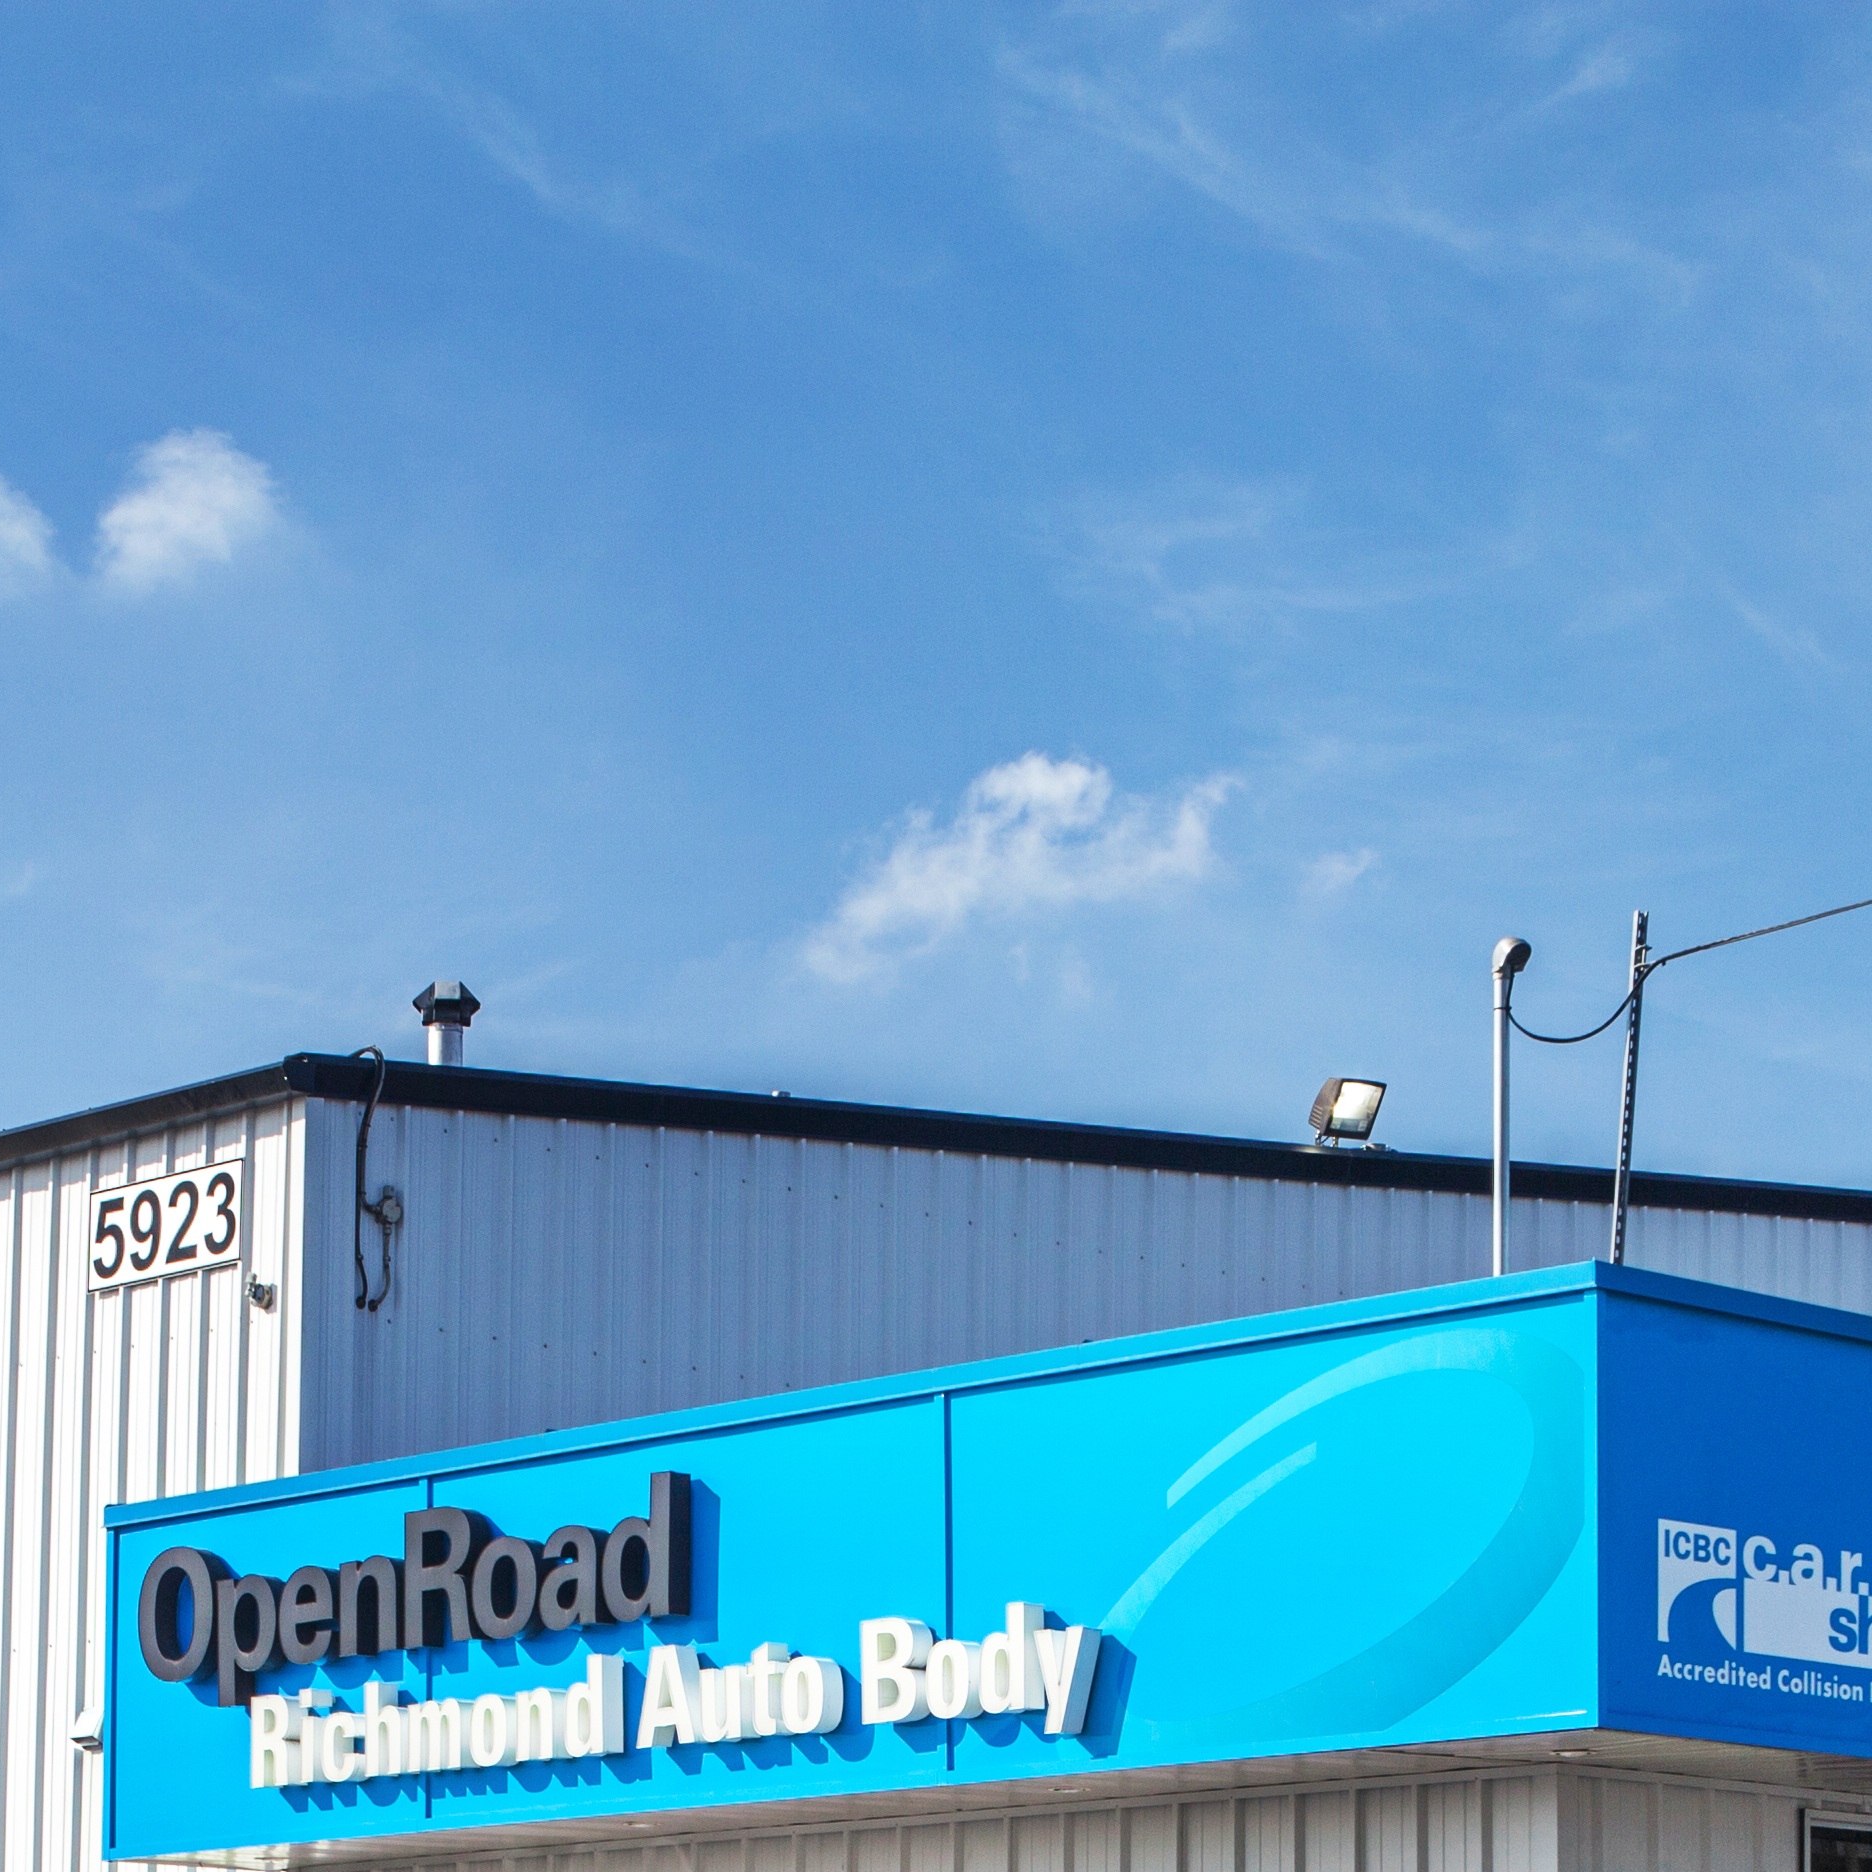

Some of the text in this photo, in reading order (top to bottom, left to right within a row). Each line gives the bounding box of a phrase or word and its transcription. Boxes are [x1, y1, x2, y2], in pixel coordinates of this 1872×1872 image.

[93, 1172, 236, 1279] 5923
[138, 1471, 691, 1706] OpenRoad
[1664, 1529, 1731, 1566] ICBC
[250, 1602, 1102, 1789] Richmond Auto Body
[1657, 1653, 1772, 1690] Accredited
[1777, 1669, 1864, 1702] Collision
